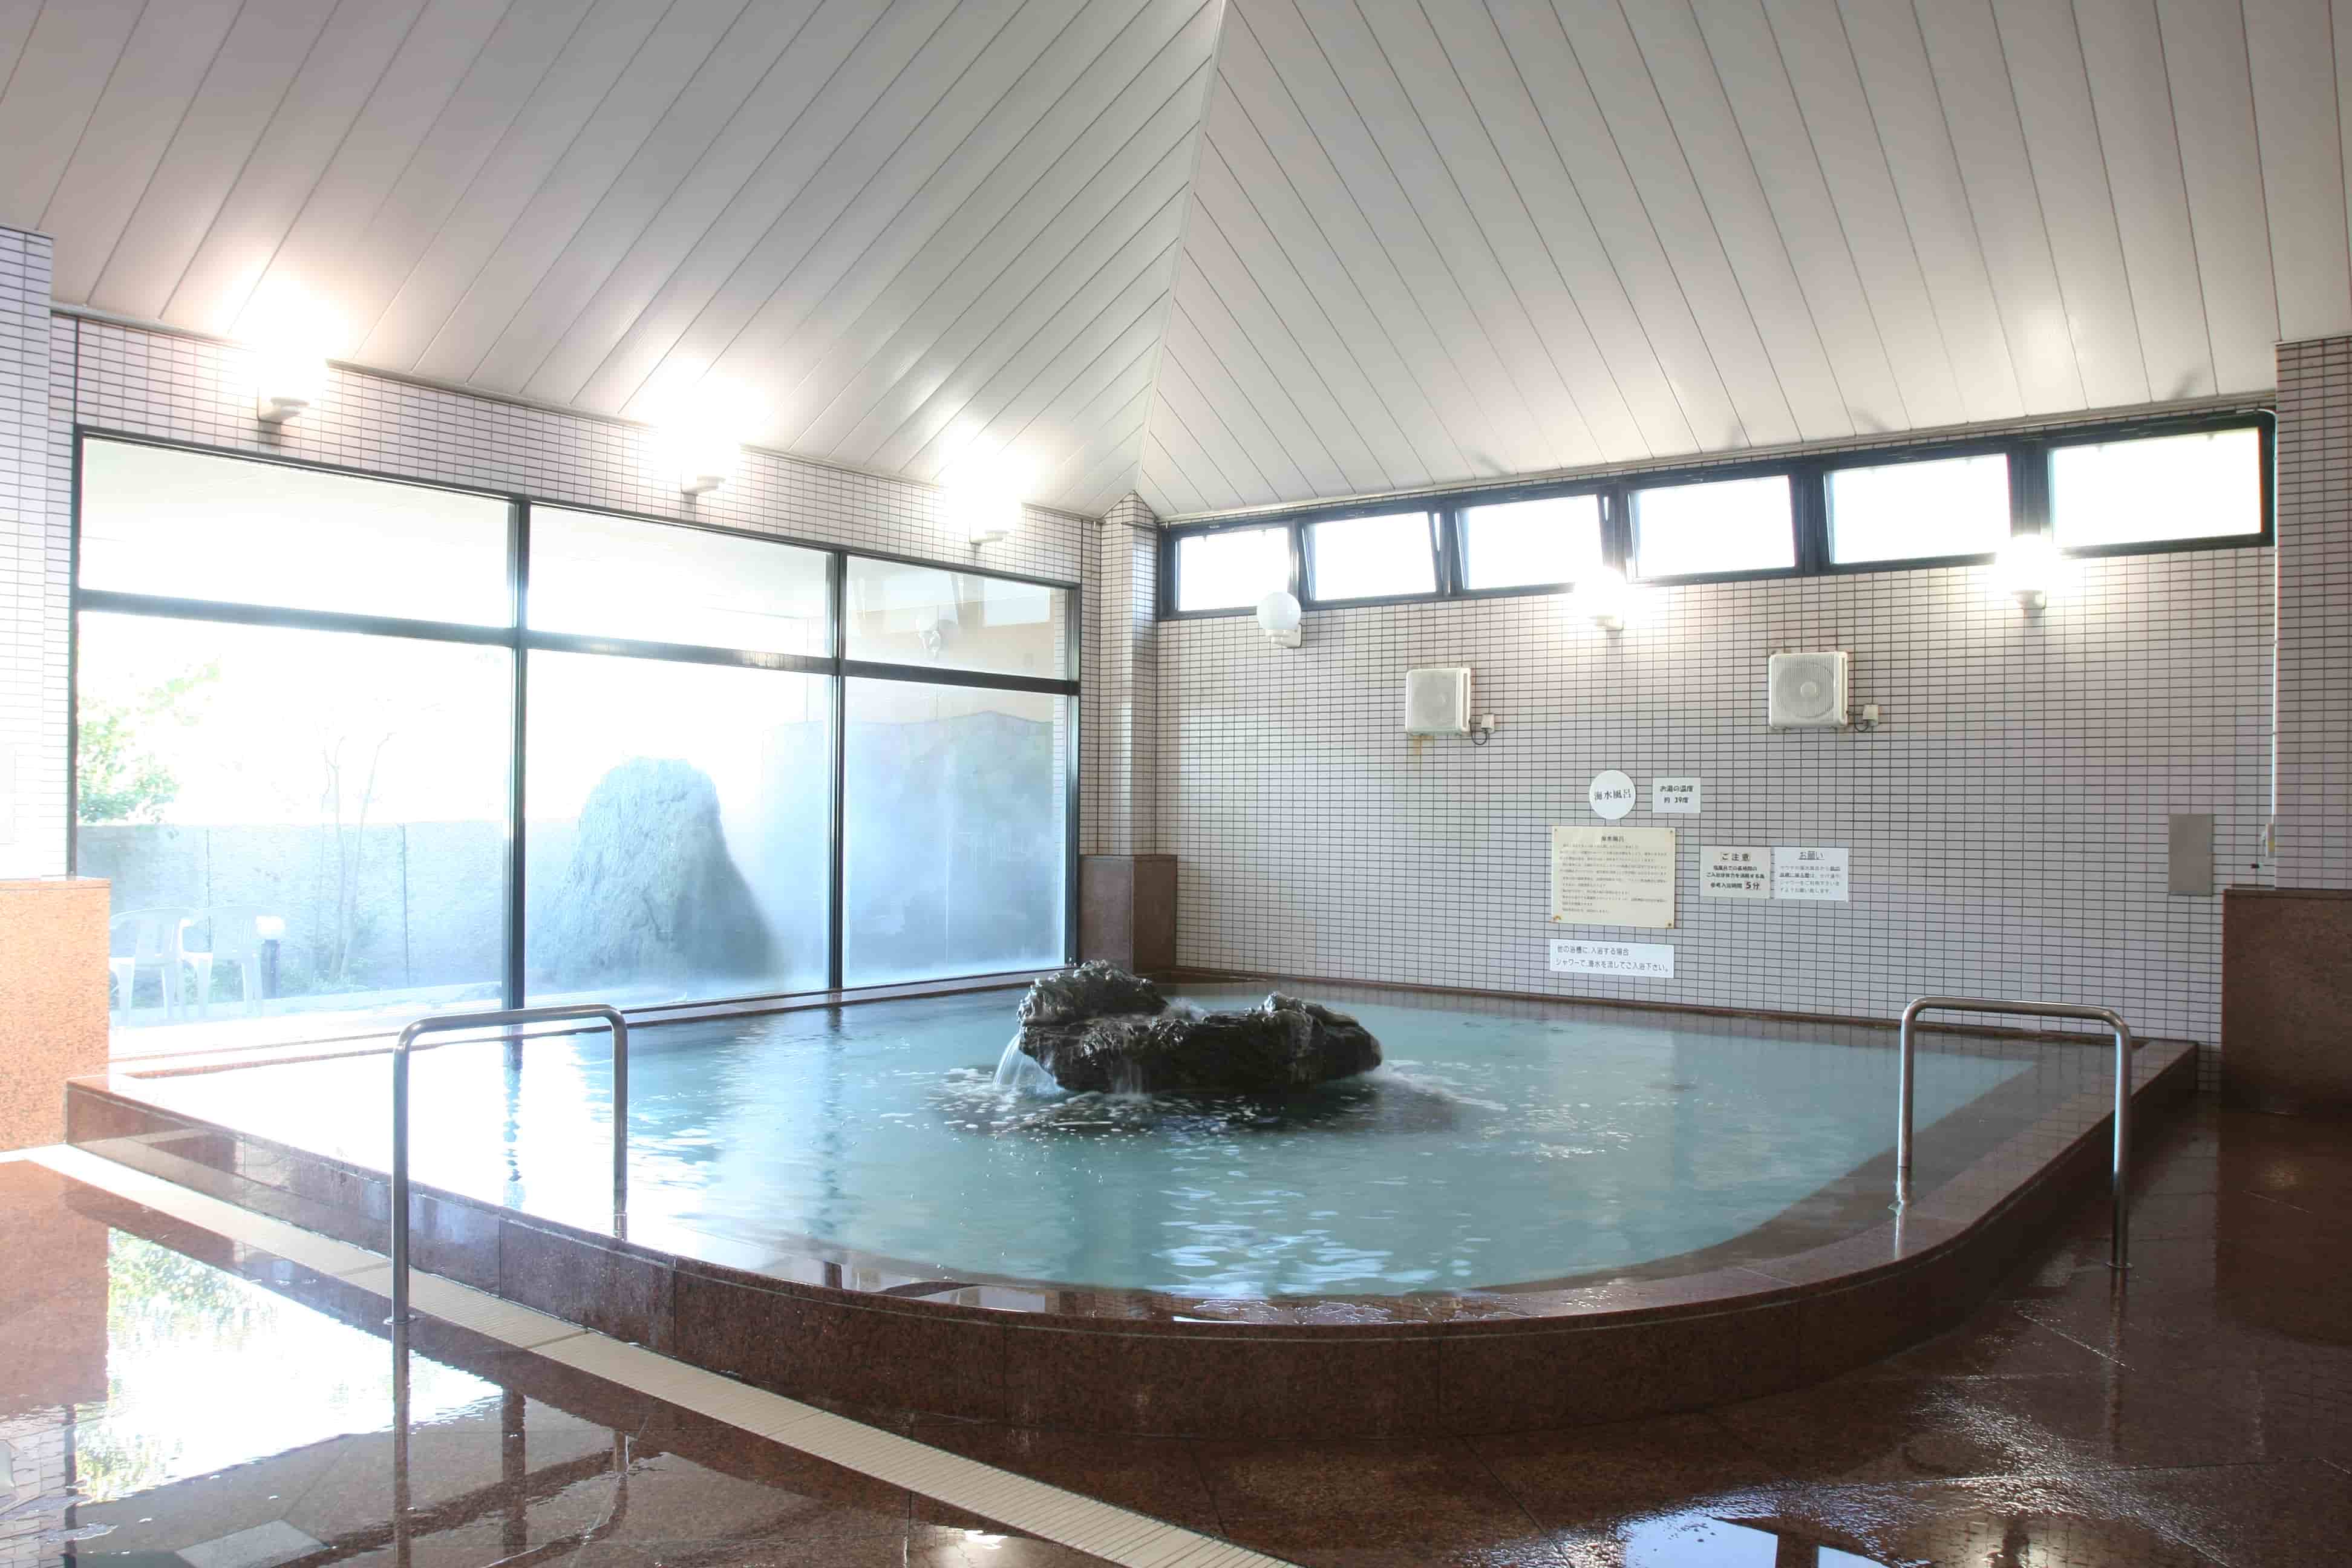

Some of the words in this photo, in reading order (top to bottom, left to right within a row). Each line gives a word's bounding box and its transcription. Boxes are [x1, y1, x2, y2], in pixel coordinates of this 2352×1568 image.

[1594, 788, 1632, 801] 海水風呂
[1722, 852, 1751, 861] ご注意
